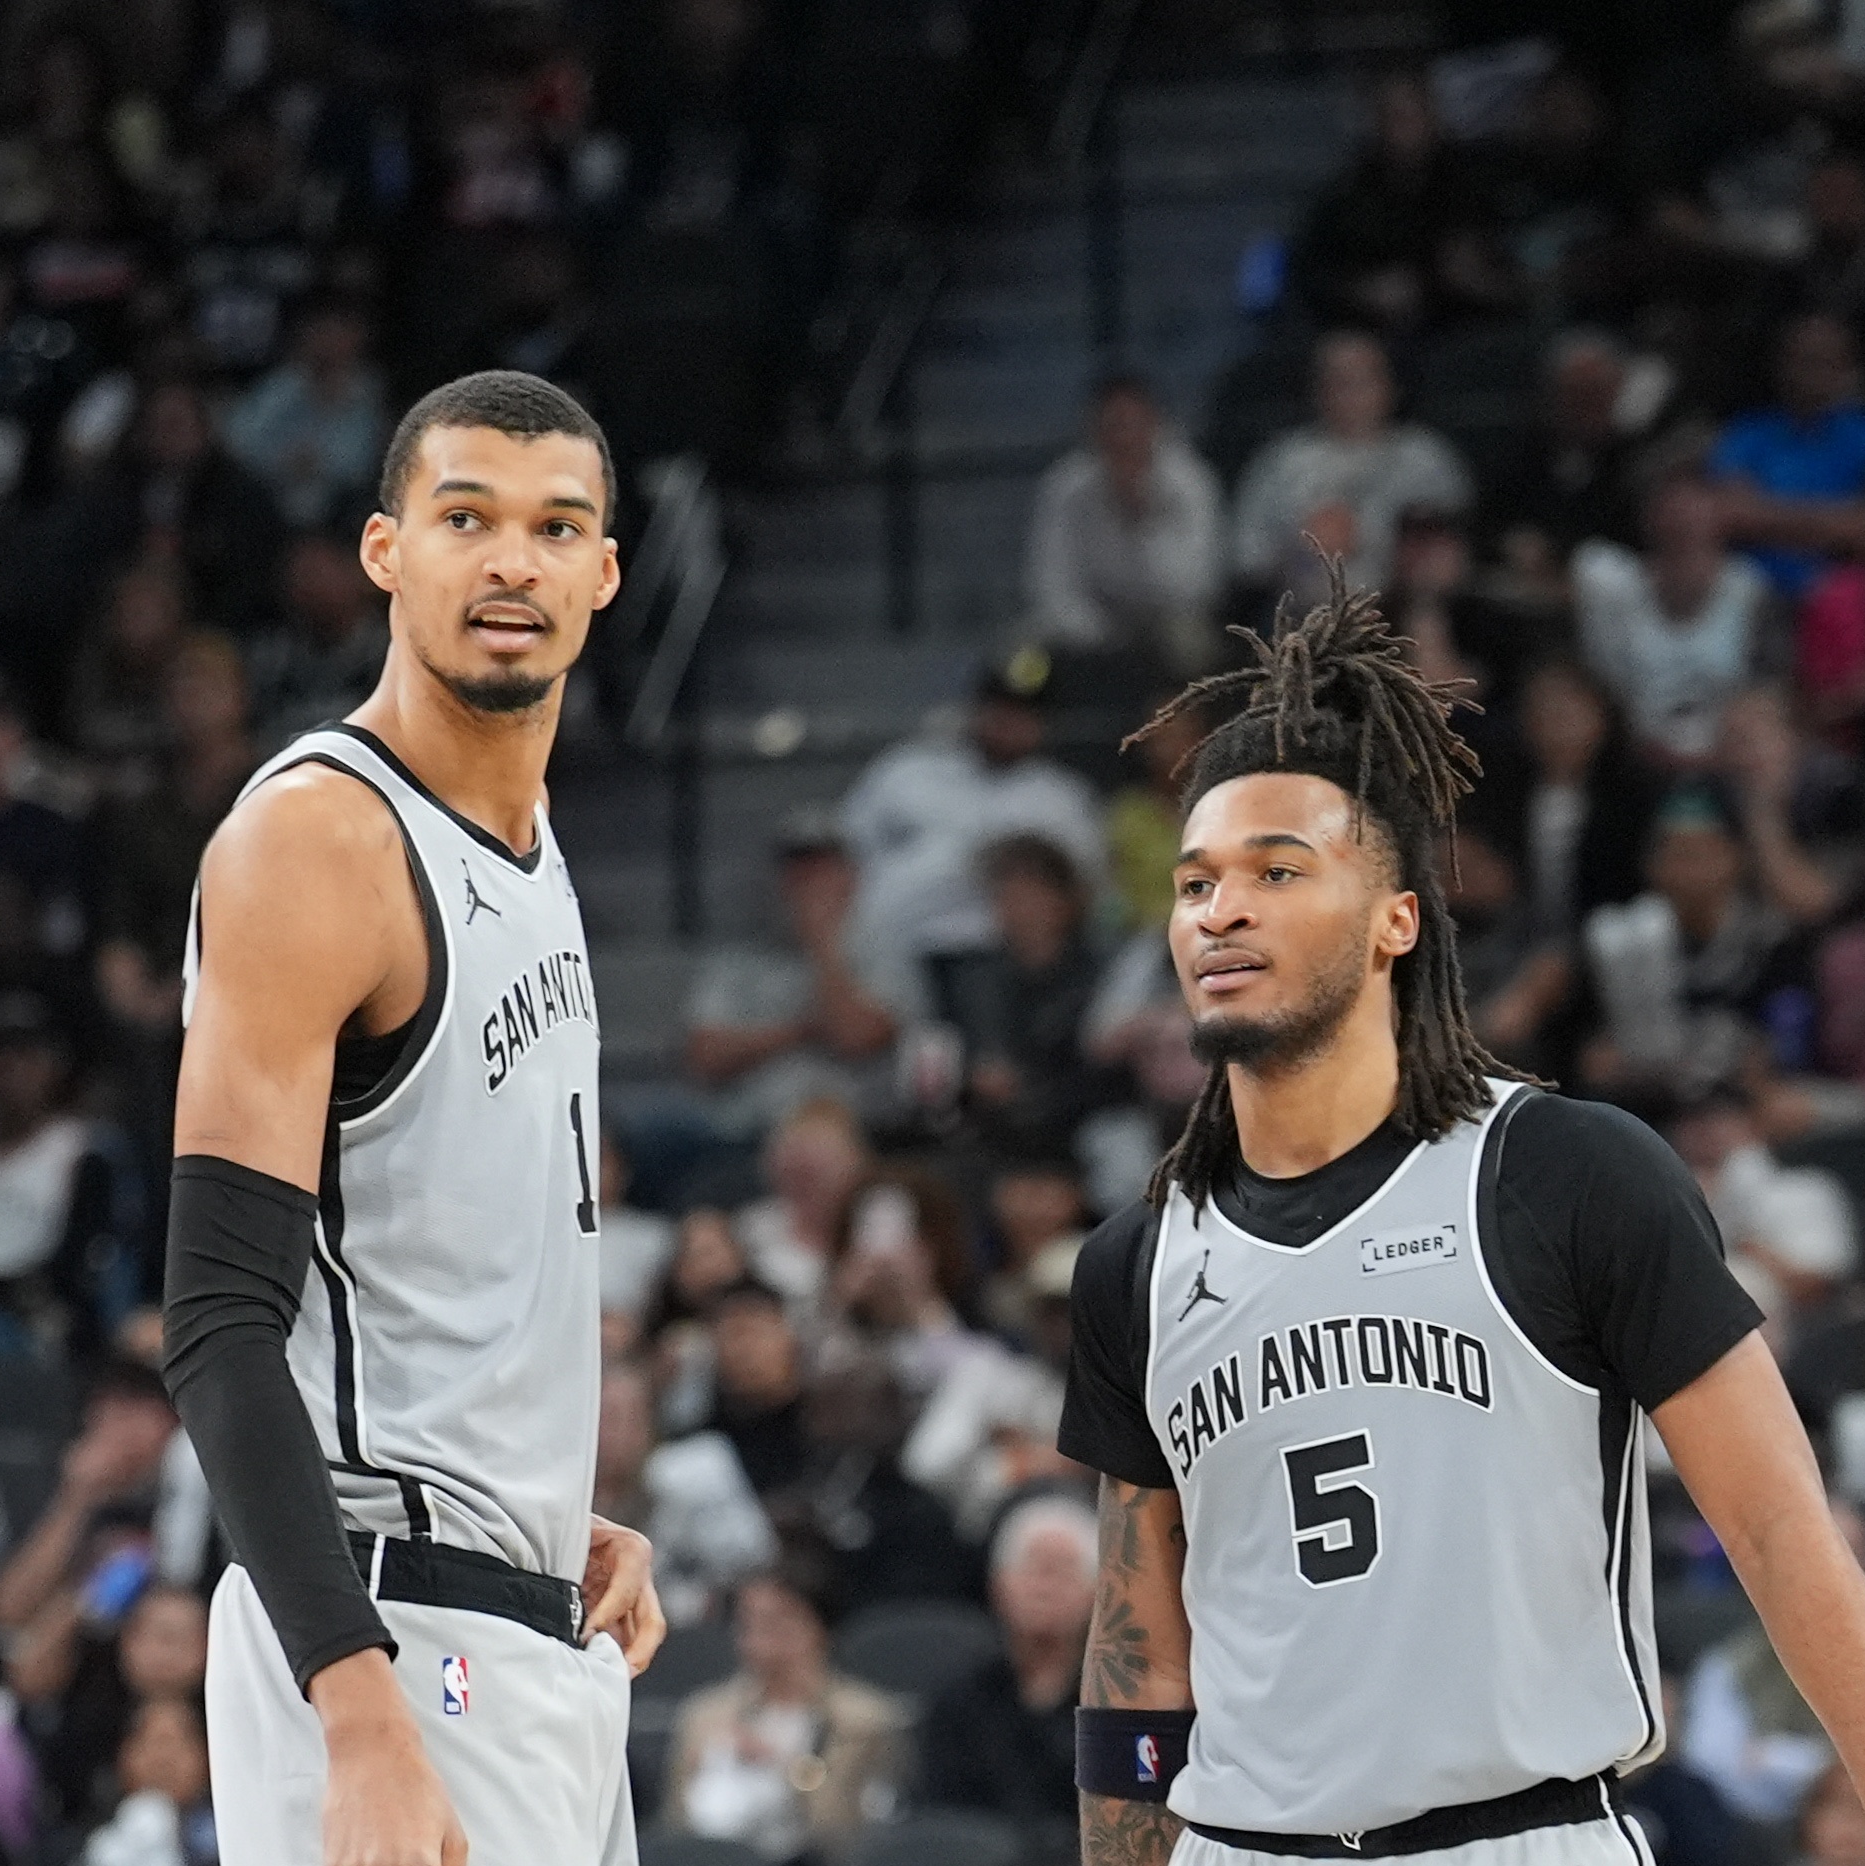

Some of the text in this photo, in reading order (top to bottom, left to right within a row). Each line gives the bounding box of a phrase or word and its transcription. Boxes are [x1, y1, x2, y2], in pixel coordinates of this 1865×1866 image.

[481, 971, 542, 1096] SAN
[569, 1088, 600, 1238] 1
[1373, 1236, 1444, 1261] LEDGER
[1165, 1314, 1495, 1482] SAN ANTONIO
[1279, 1428, 1383, 1589] 5
